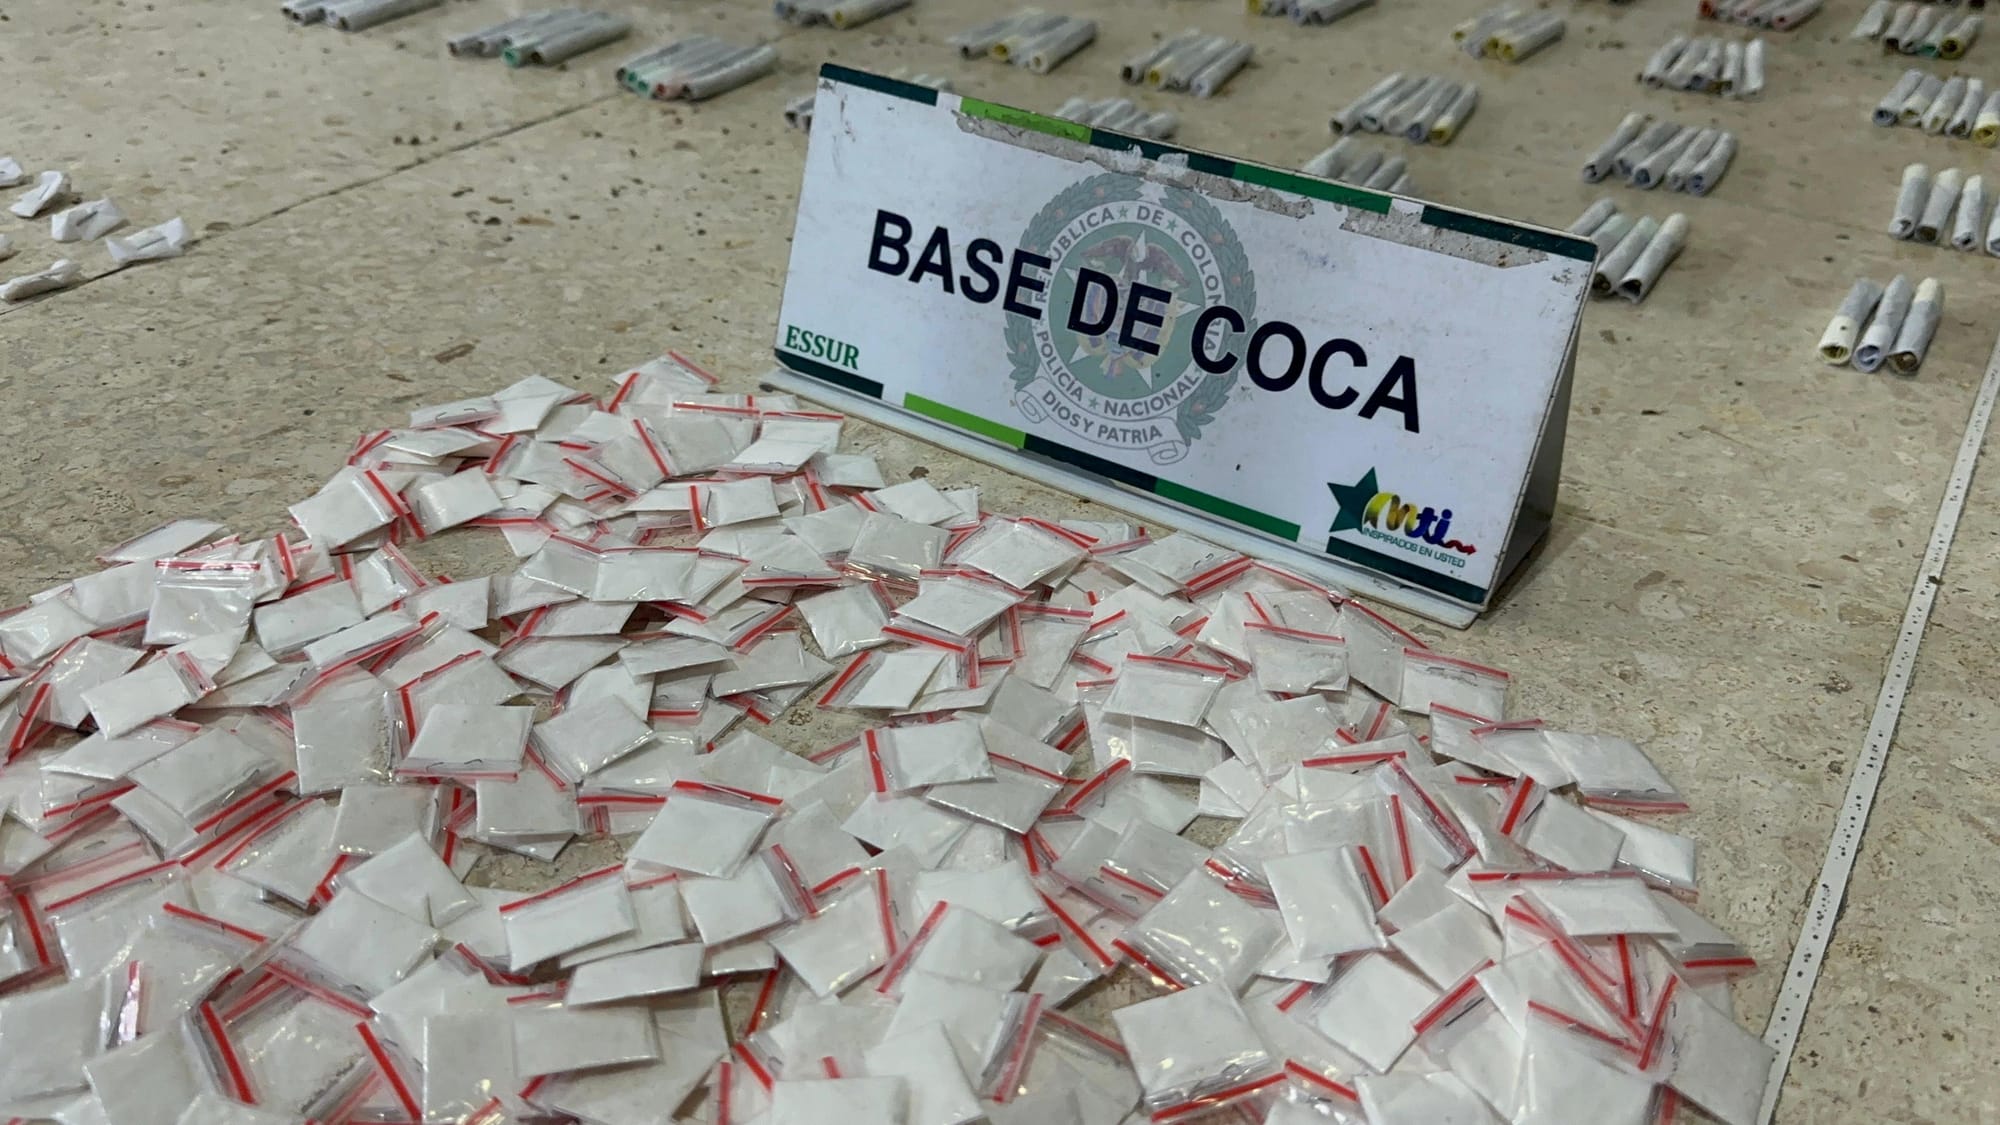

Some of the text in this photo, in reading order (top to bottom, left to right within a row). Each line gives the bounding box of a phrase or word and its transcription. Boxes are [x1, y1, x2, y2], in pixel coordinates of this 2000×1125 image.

[1136, 205, 1165, 227] DE
[868, 209, 1420, 434] BASE DE COCA
[785, 324, 859, 371] ESSUR
[1042, 390, 1163, 444] DIOS Y PATRIA
[1104, 372, 1200, 417] NACIONAL
[1363, 527, 1466, 568] INSPIRADOS EN USTED
